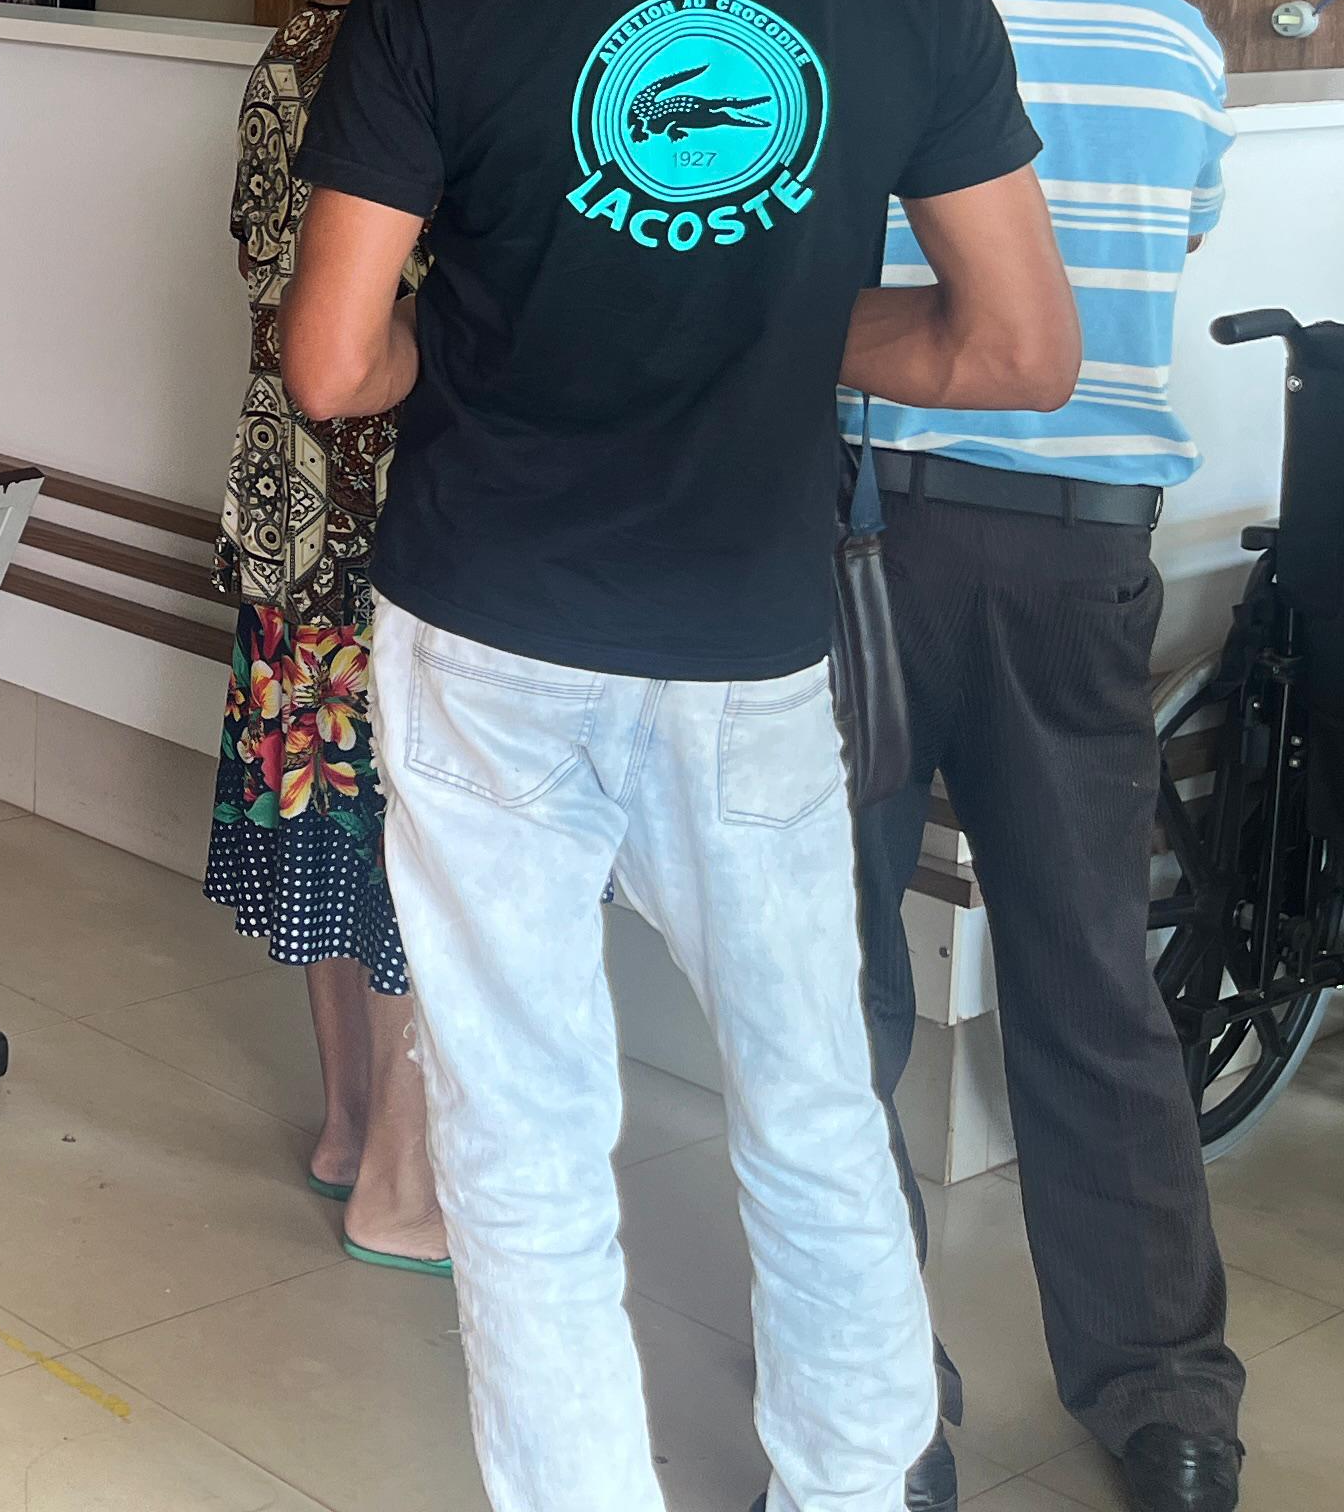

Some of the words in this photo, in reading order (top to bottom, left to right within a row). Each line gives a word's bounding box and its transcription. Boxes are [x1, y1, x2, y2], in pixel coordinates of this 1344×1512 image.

[598, 0, 675, 65] ATTETION
[672, 150, 719, 168] 1927
[566, 169, 813, 251] LACOSTE
